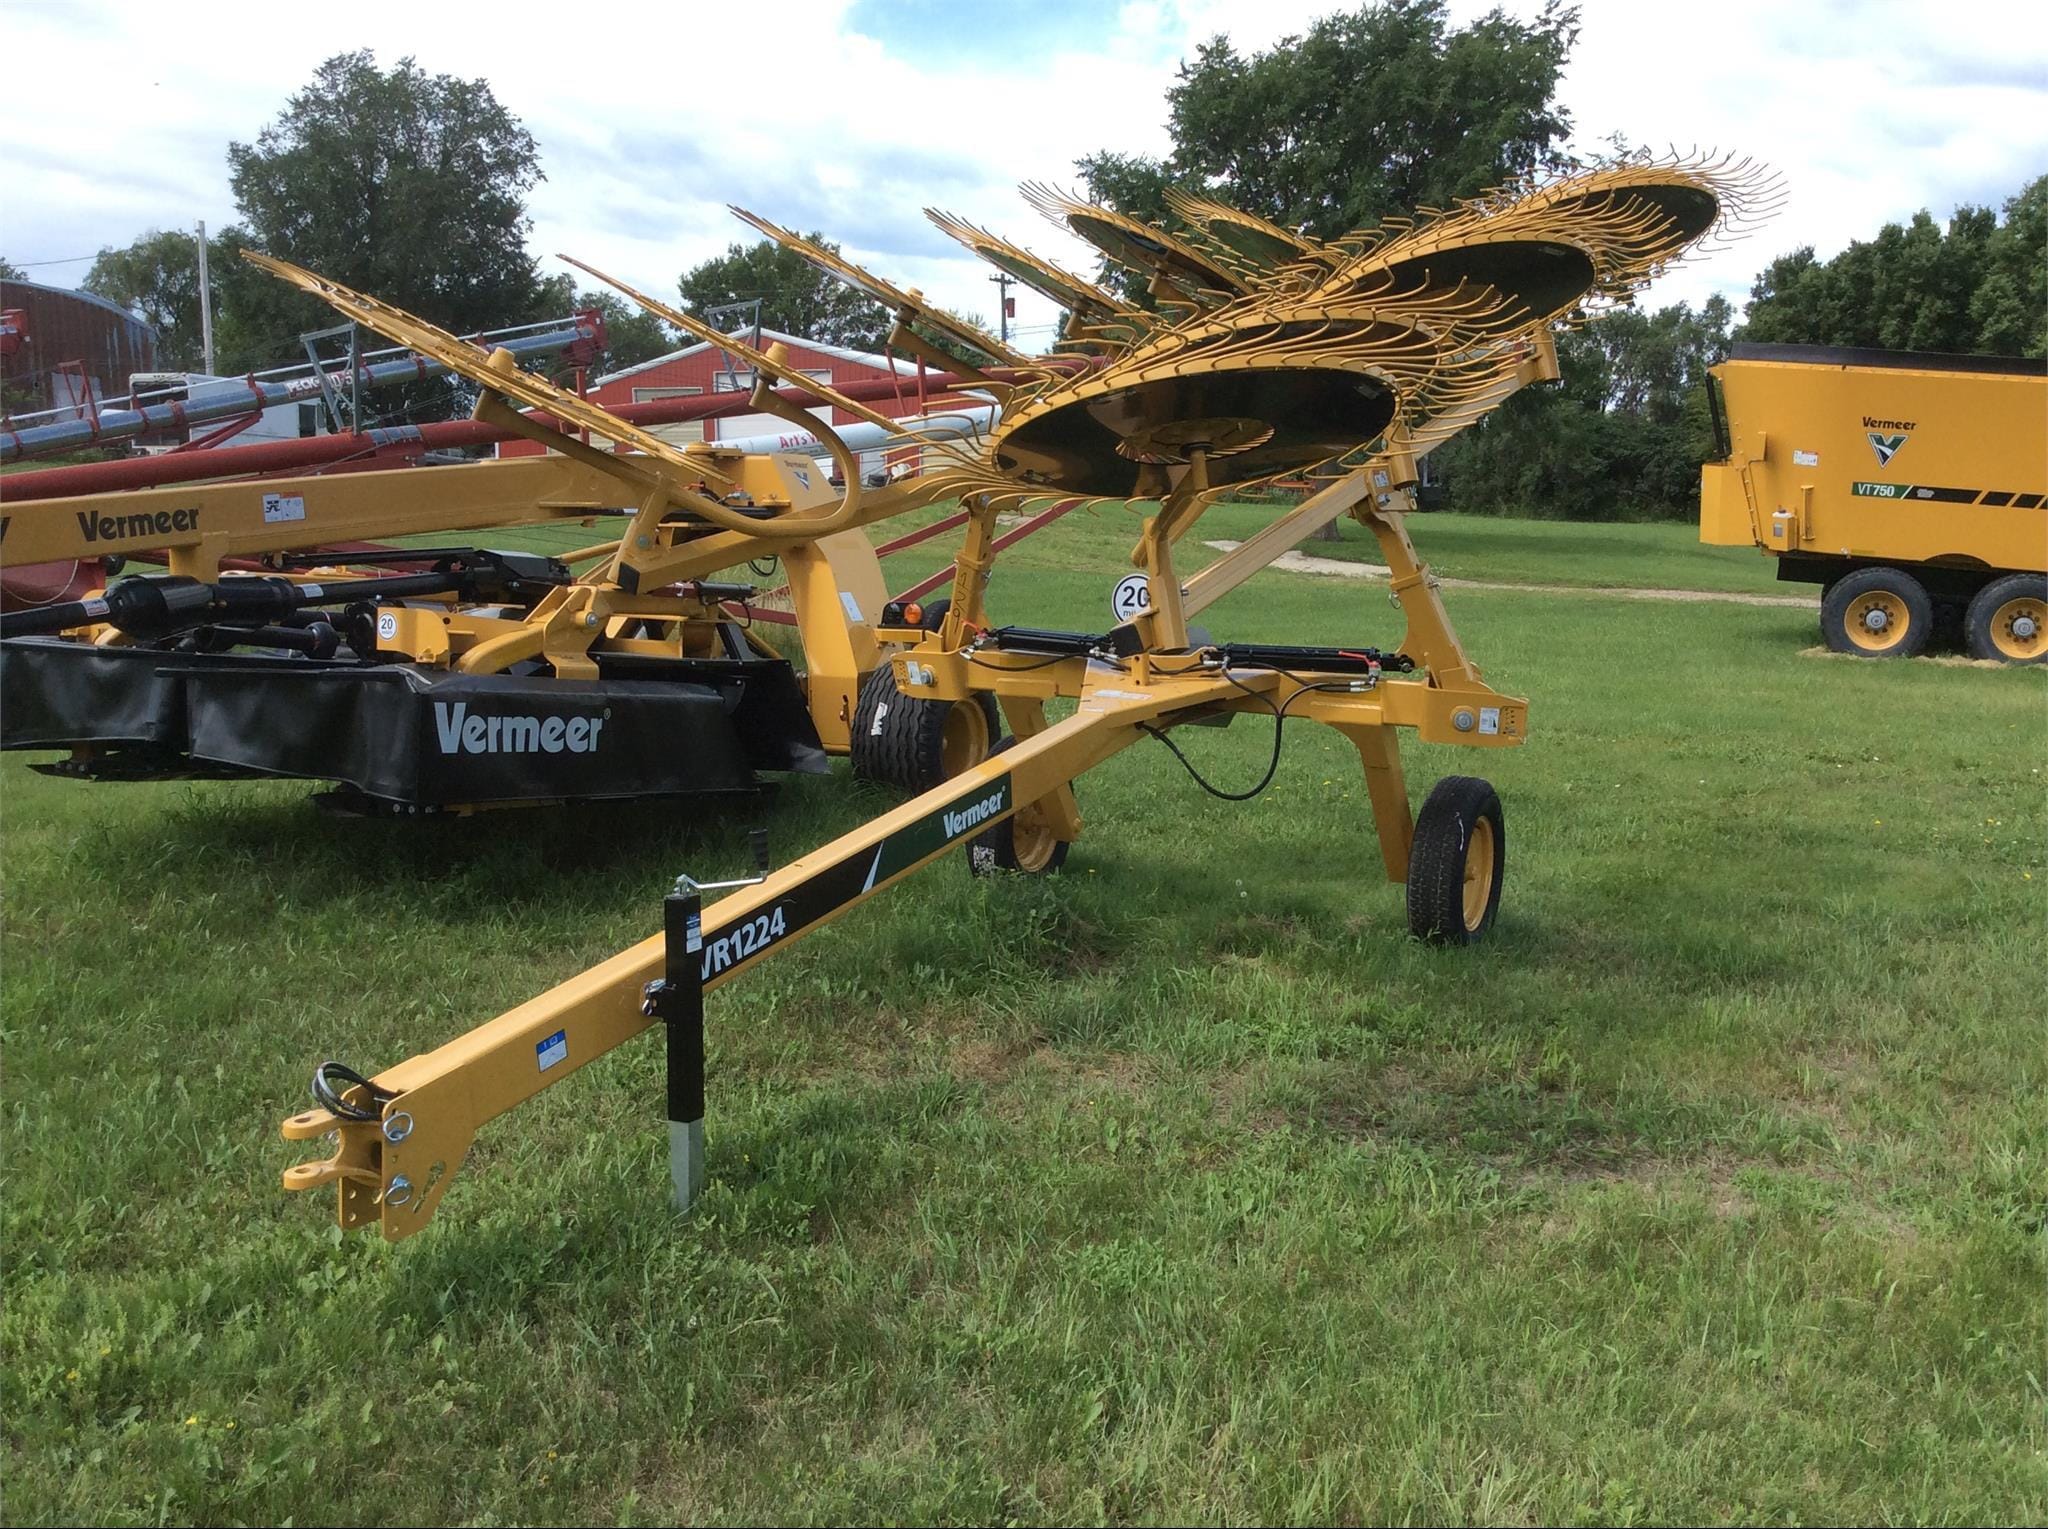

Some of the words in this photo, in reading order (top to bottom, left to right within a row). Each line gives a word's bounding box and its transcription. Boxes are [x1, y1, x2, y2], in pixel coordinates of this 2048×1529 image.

[1862, 416, 1916, 431] Vermeer
[76, 508, 200, 542] Vermeer
[381, 617, 393, 629] 20
[433, 702, 603, 754] Vermeer
[943, 790, 1003, 839] Vermeer
